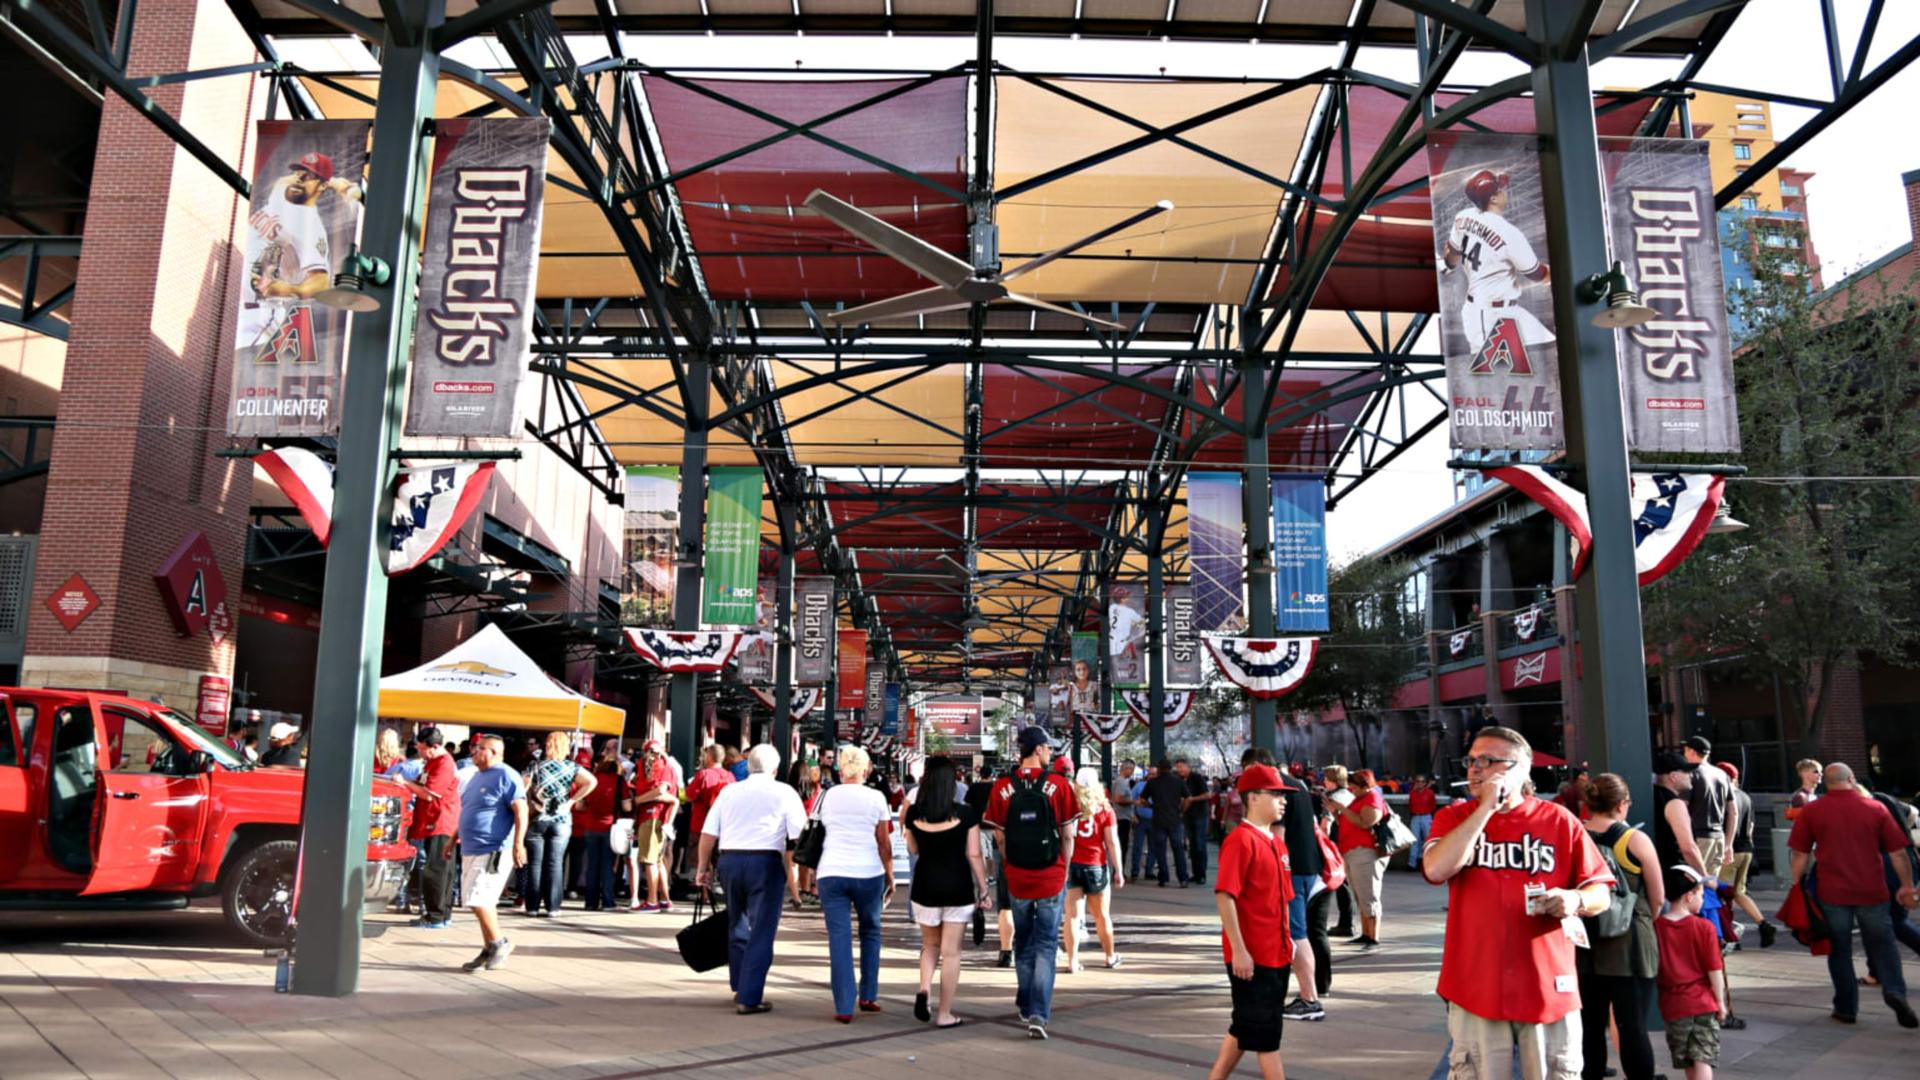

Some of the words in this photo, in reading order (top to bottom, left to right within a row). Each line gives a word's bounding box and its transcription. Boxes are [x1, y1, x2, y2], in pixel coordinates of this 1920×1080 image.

[435, 383, 492, 392] dbacks.com
[1453, 397, 1496, 407] PAUL
[1648, 400, 1703, 409] dbacks.com
[236, 398, 329, 421] COLLMENTER
[1454, 409, 1554, 431] GOLDSCHMIDT
[186, 568, 207, 616] A
[733, 588, 753, 599] aps
[1305, 593, 1326, 604] aps
[1467, 832, 1555, 874] backs
